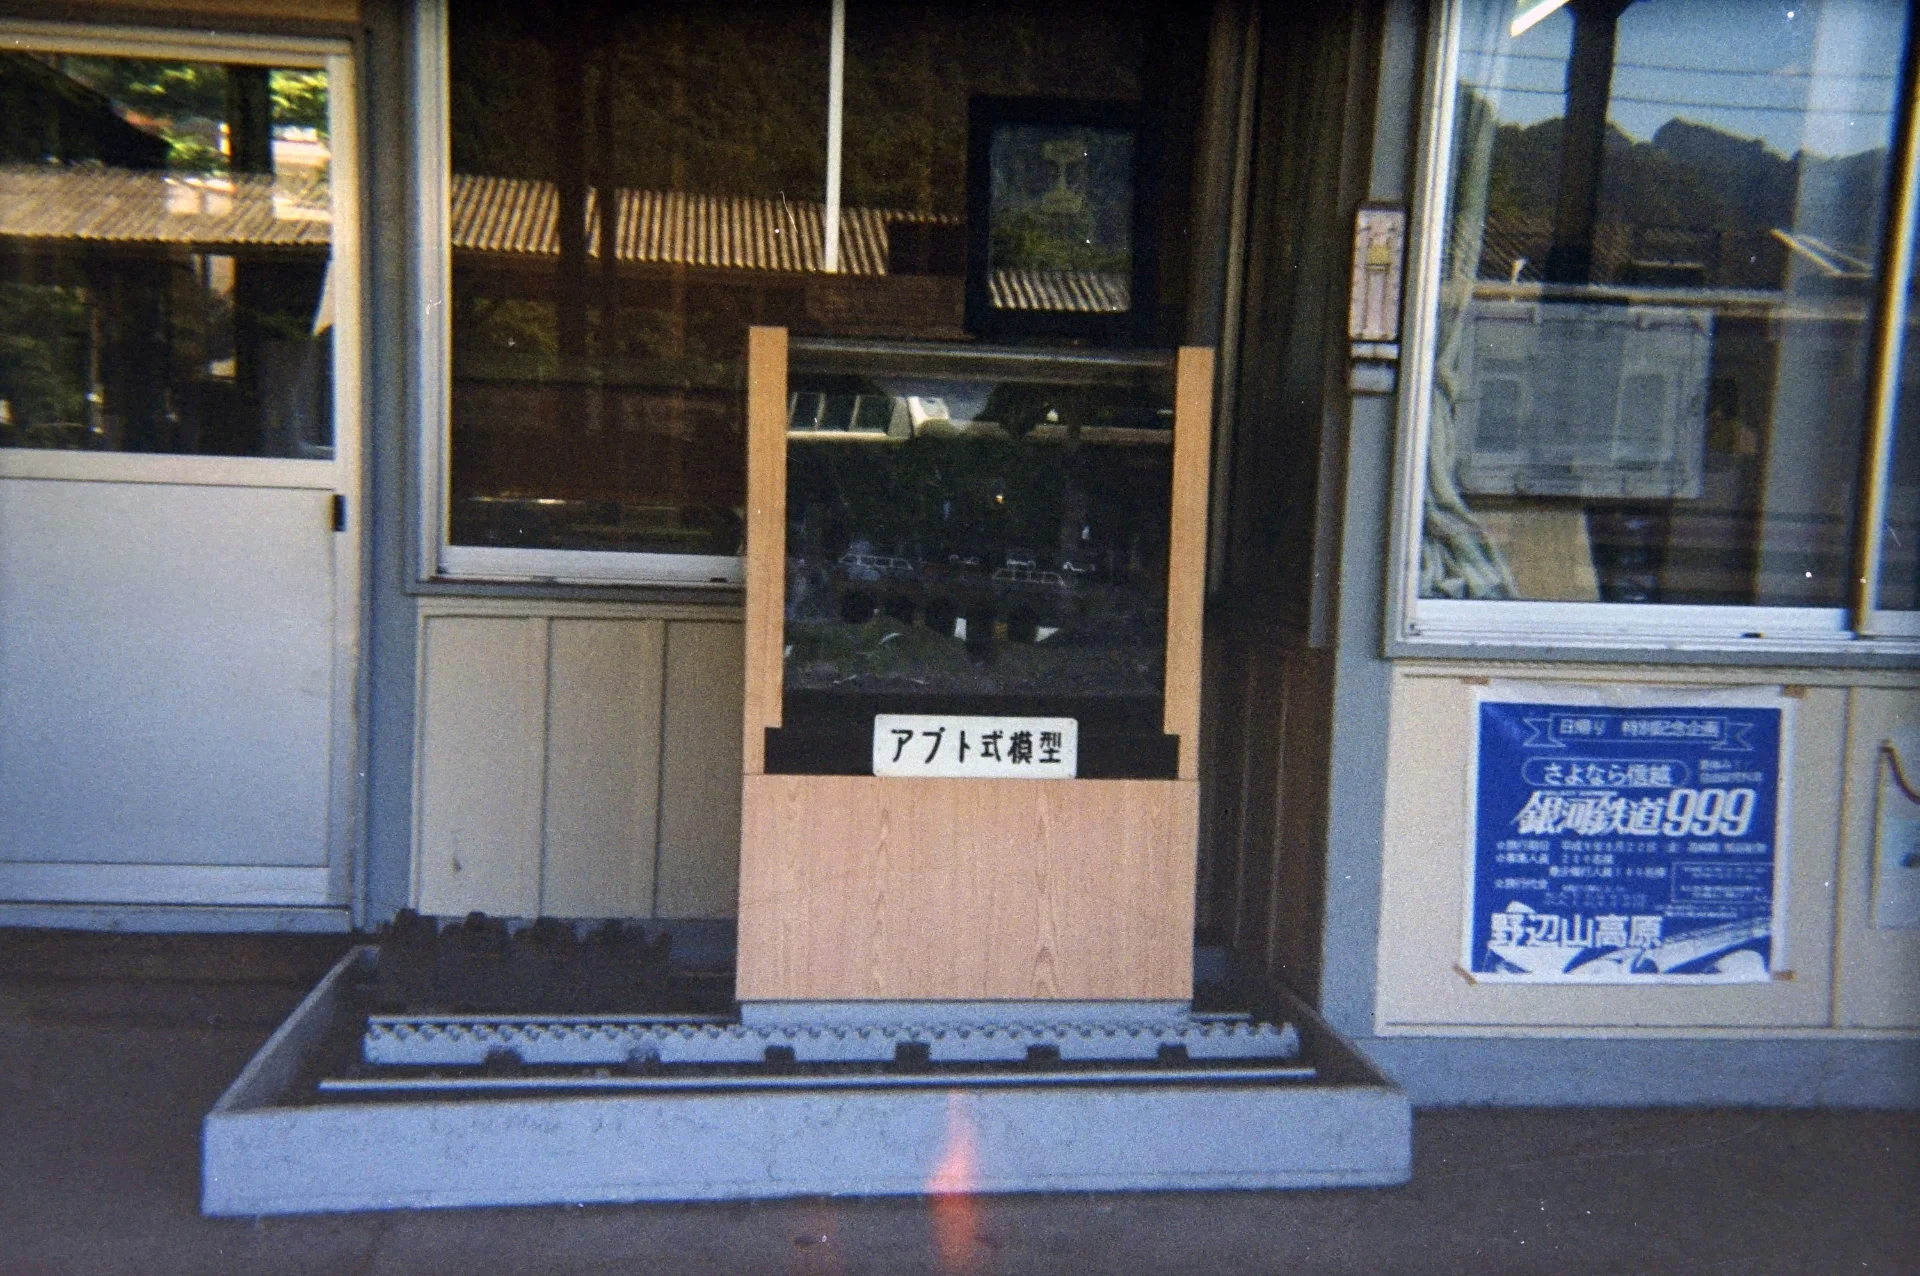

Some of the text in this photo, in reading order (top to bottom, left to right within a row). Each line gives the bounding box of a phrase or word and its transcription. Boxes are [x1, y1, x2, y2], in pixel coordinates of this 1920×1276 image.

[890, 726, 1063, 765] アプト式模型
[1543, 762, 1672, 787] さよなら信越
[1510, 788, 1756, 836] 銀河鉄道999
[1490, 913, 1664, 949] 野辺山高原
